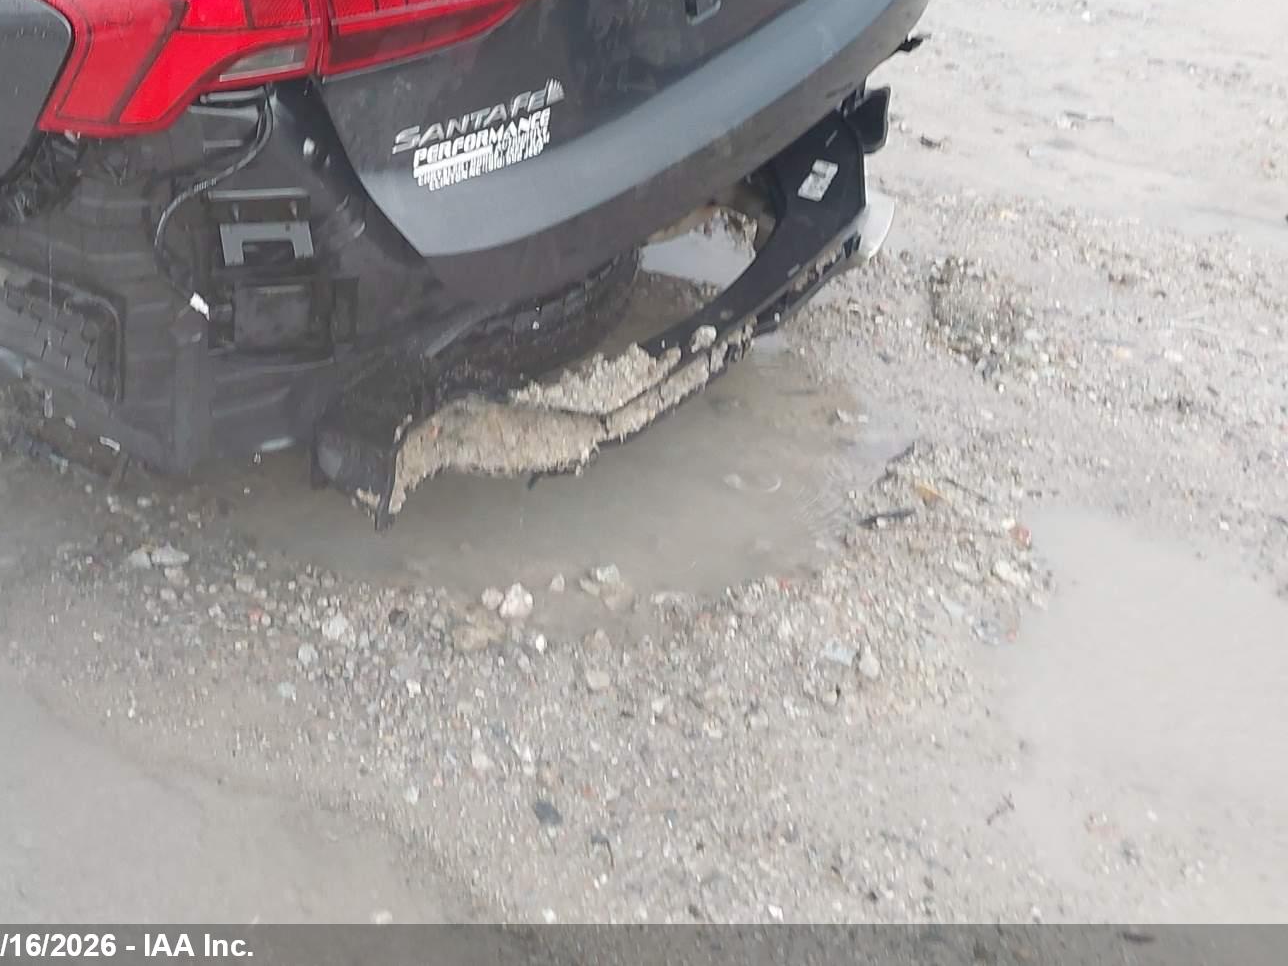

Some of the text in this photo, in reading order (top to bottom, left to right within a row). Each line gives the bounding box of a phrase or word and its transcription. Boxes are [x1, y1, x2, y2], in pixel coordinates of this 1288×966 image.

[392, 103, 507, 155] SANTA
[511, 90, 547, 119] FE
[414, 106, 551, 169] PERFORMANCE
